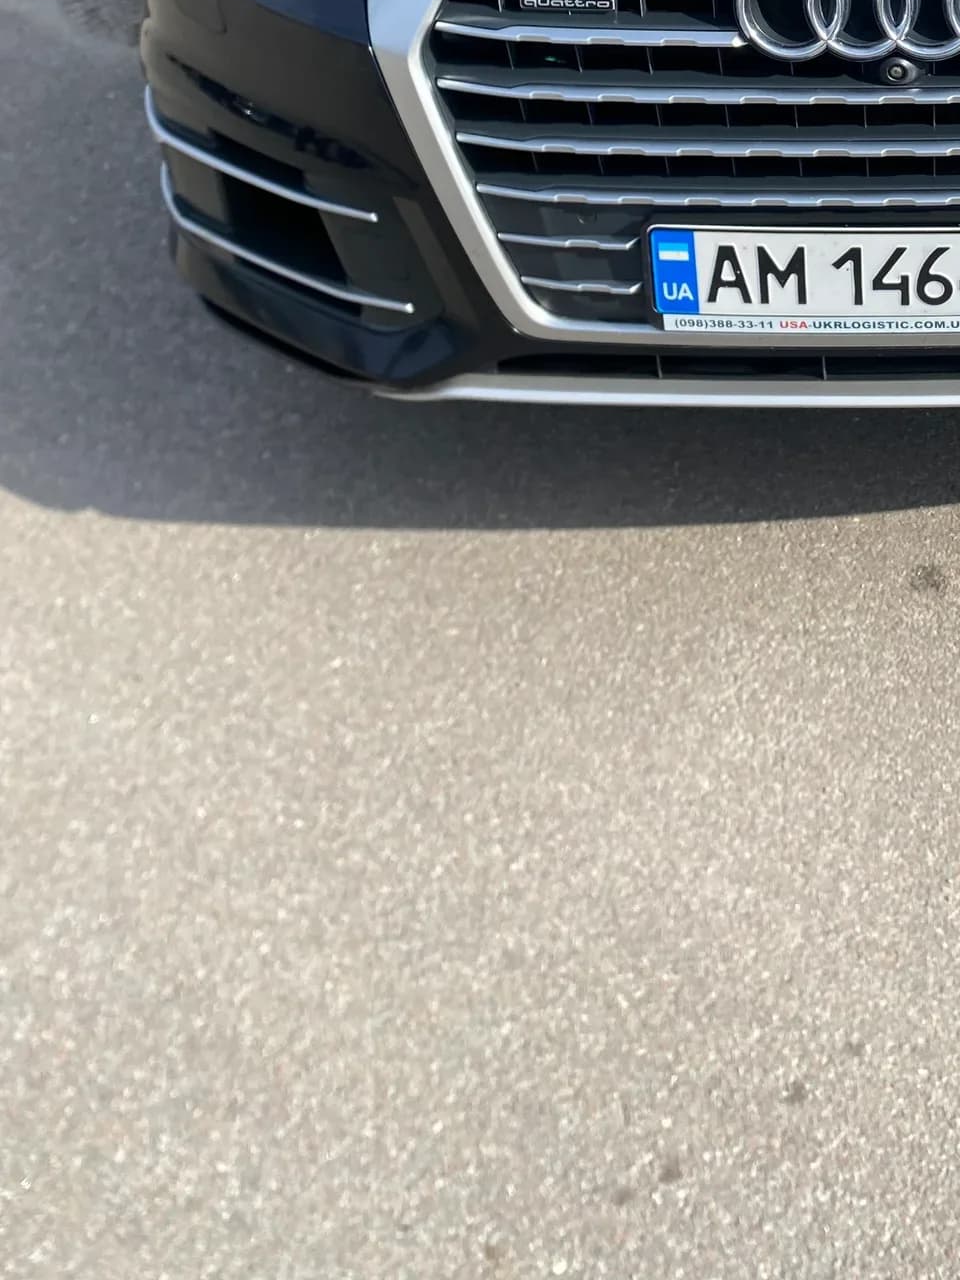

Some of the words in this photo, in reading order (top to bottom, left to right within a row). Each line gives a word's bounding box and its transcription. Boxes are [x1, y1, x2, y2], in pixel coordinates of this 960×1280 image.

[706, 245, 806, 305] AM
[663, 282, 694, 302] UA
[674, 318, 774, 330] (098)388-33-11
